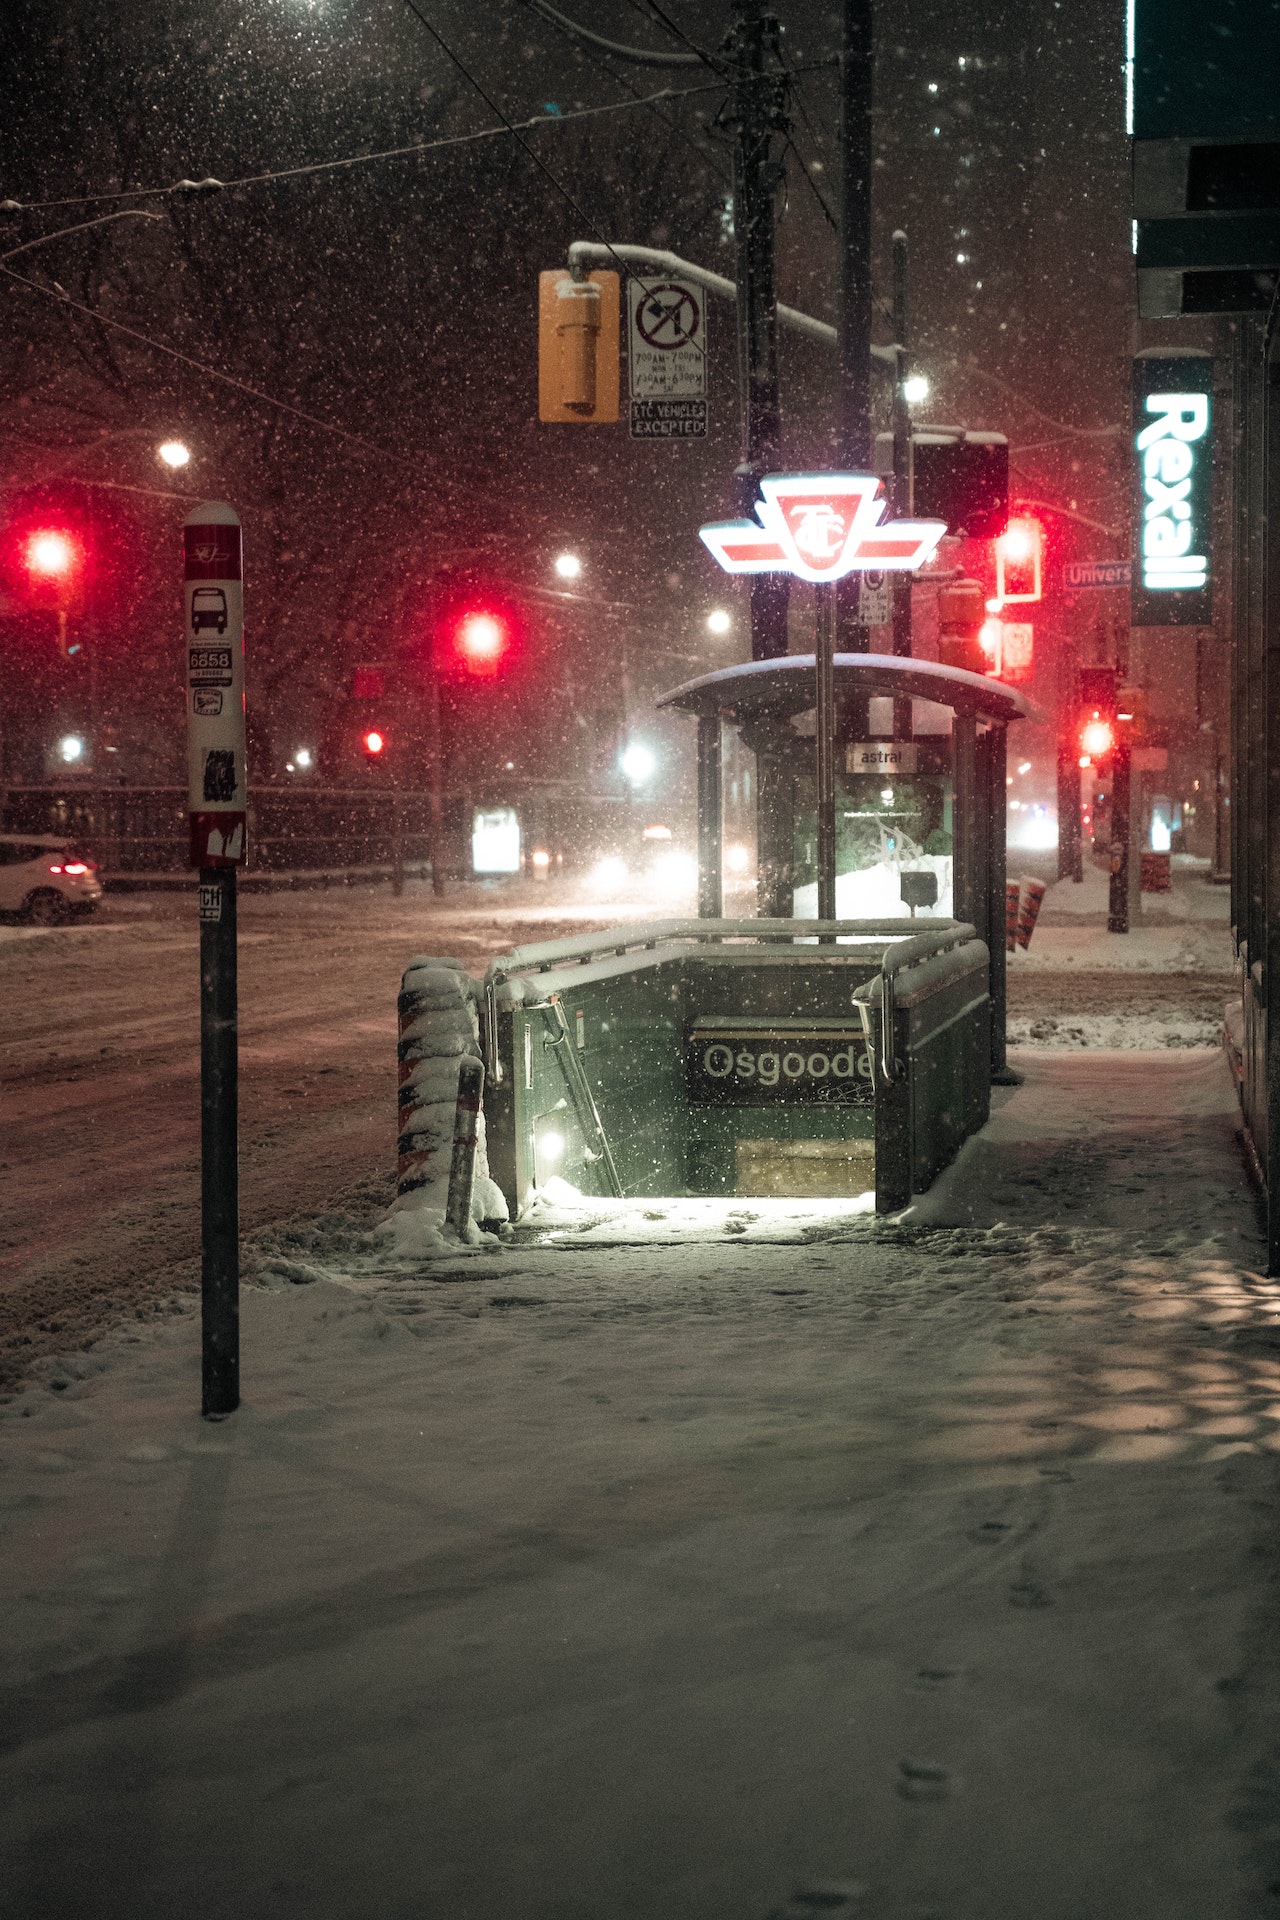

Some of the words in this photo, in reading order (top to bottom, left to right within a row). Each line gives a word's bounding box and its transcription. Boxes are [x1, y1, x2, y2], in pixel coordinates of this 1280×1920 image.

[657, 404, 705, 418] VEHICLES
[636, 420, 701, 433] EXCEPTED
[1137, 393, 1208, 588] Rexall
[861, 751, 902, 763] astral
[704, 1044, 874, 1086] Osgoode
